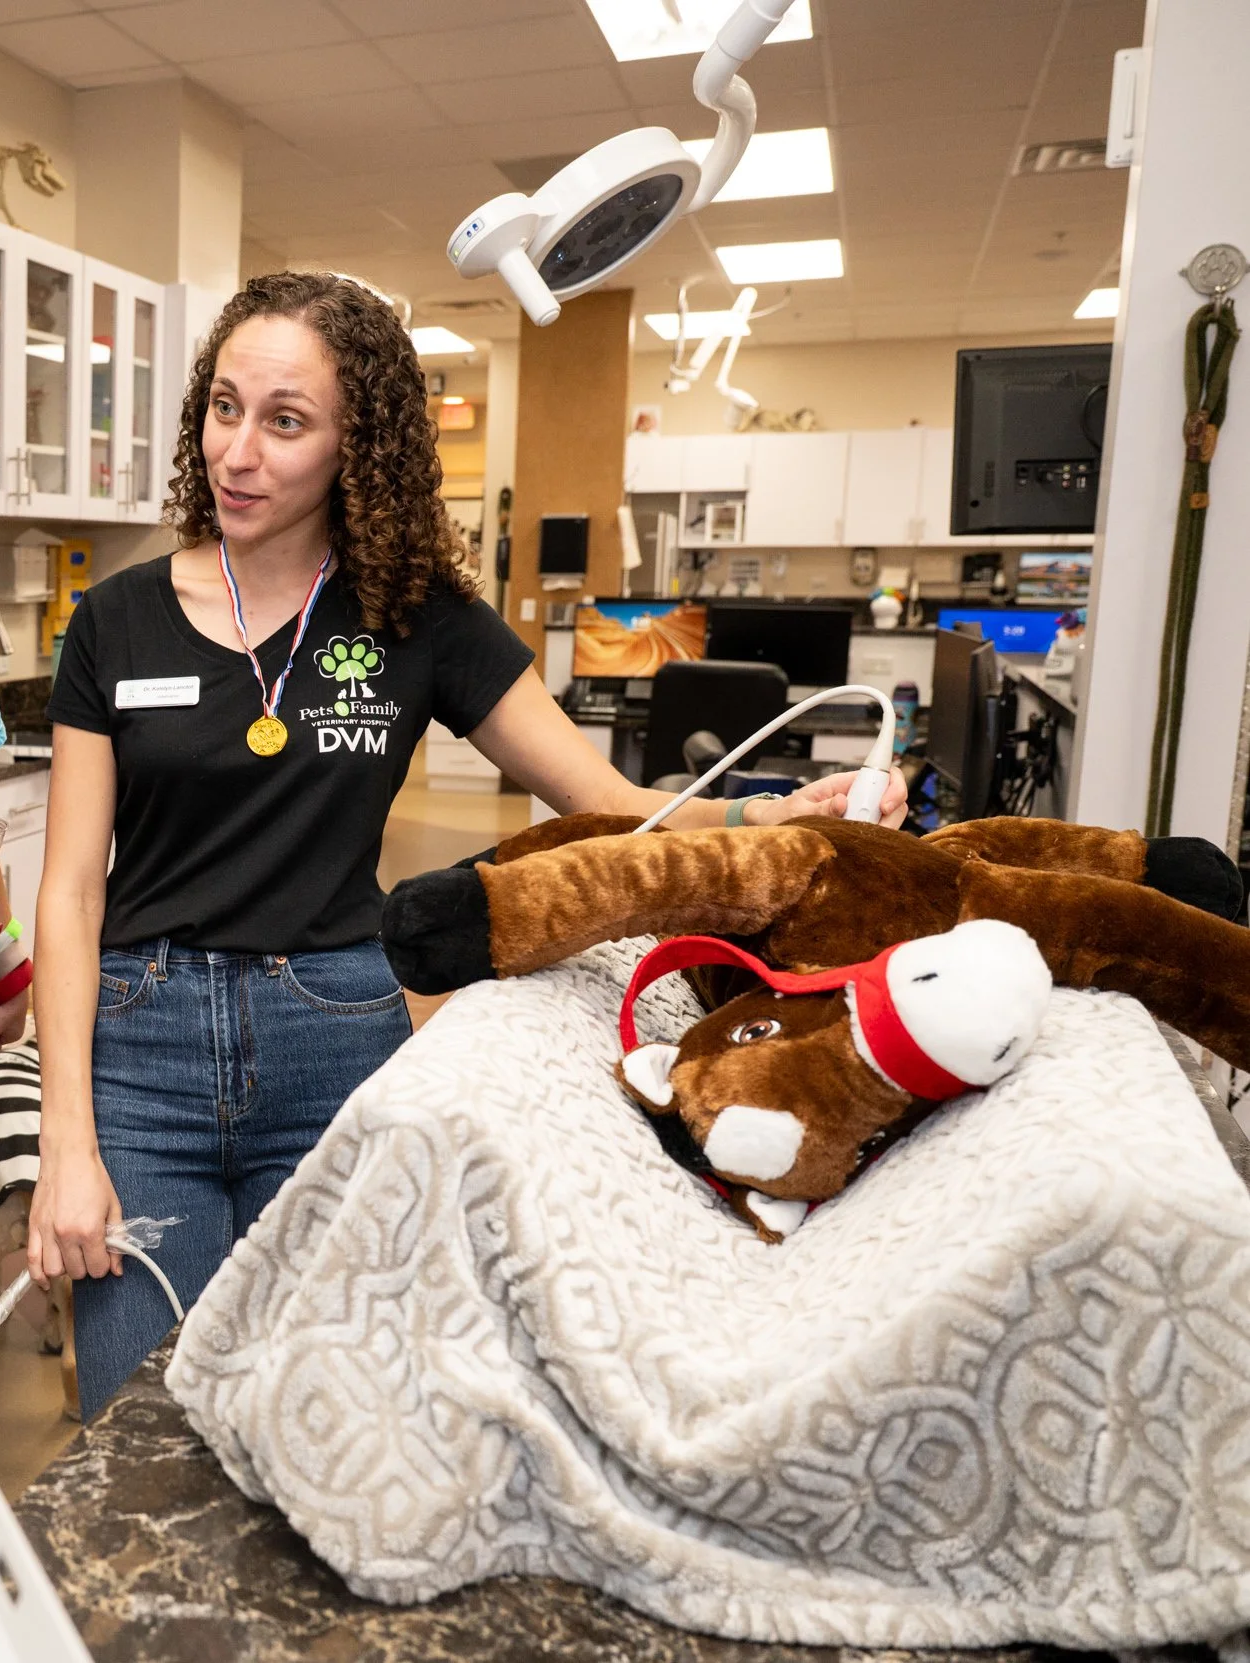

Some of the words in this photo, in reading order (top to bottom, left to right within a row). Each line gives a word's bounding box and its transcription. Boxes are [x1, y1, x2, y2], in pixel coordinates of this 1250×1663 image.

[298, 706, 334, 721] Pets
[349, 700, 402, 721] Family
[310, 718, 359, 728] VETERINARY
[360, 718, 391, 728] HOSPITAL
[317, 726, 388, 756] DVM
